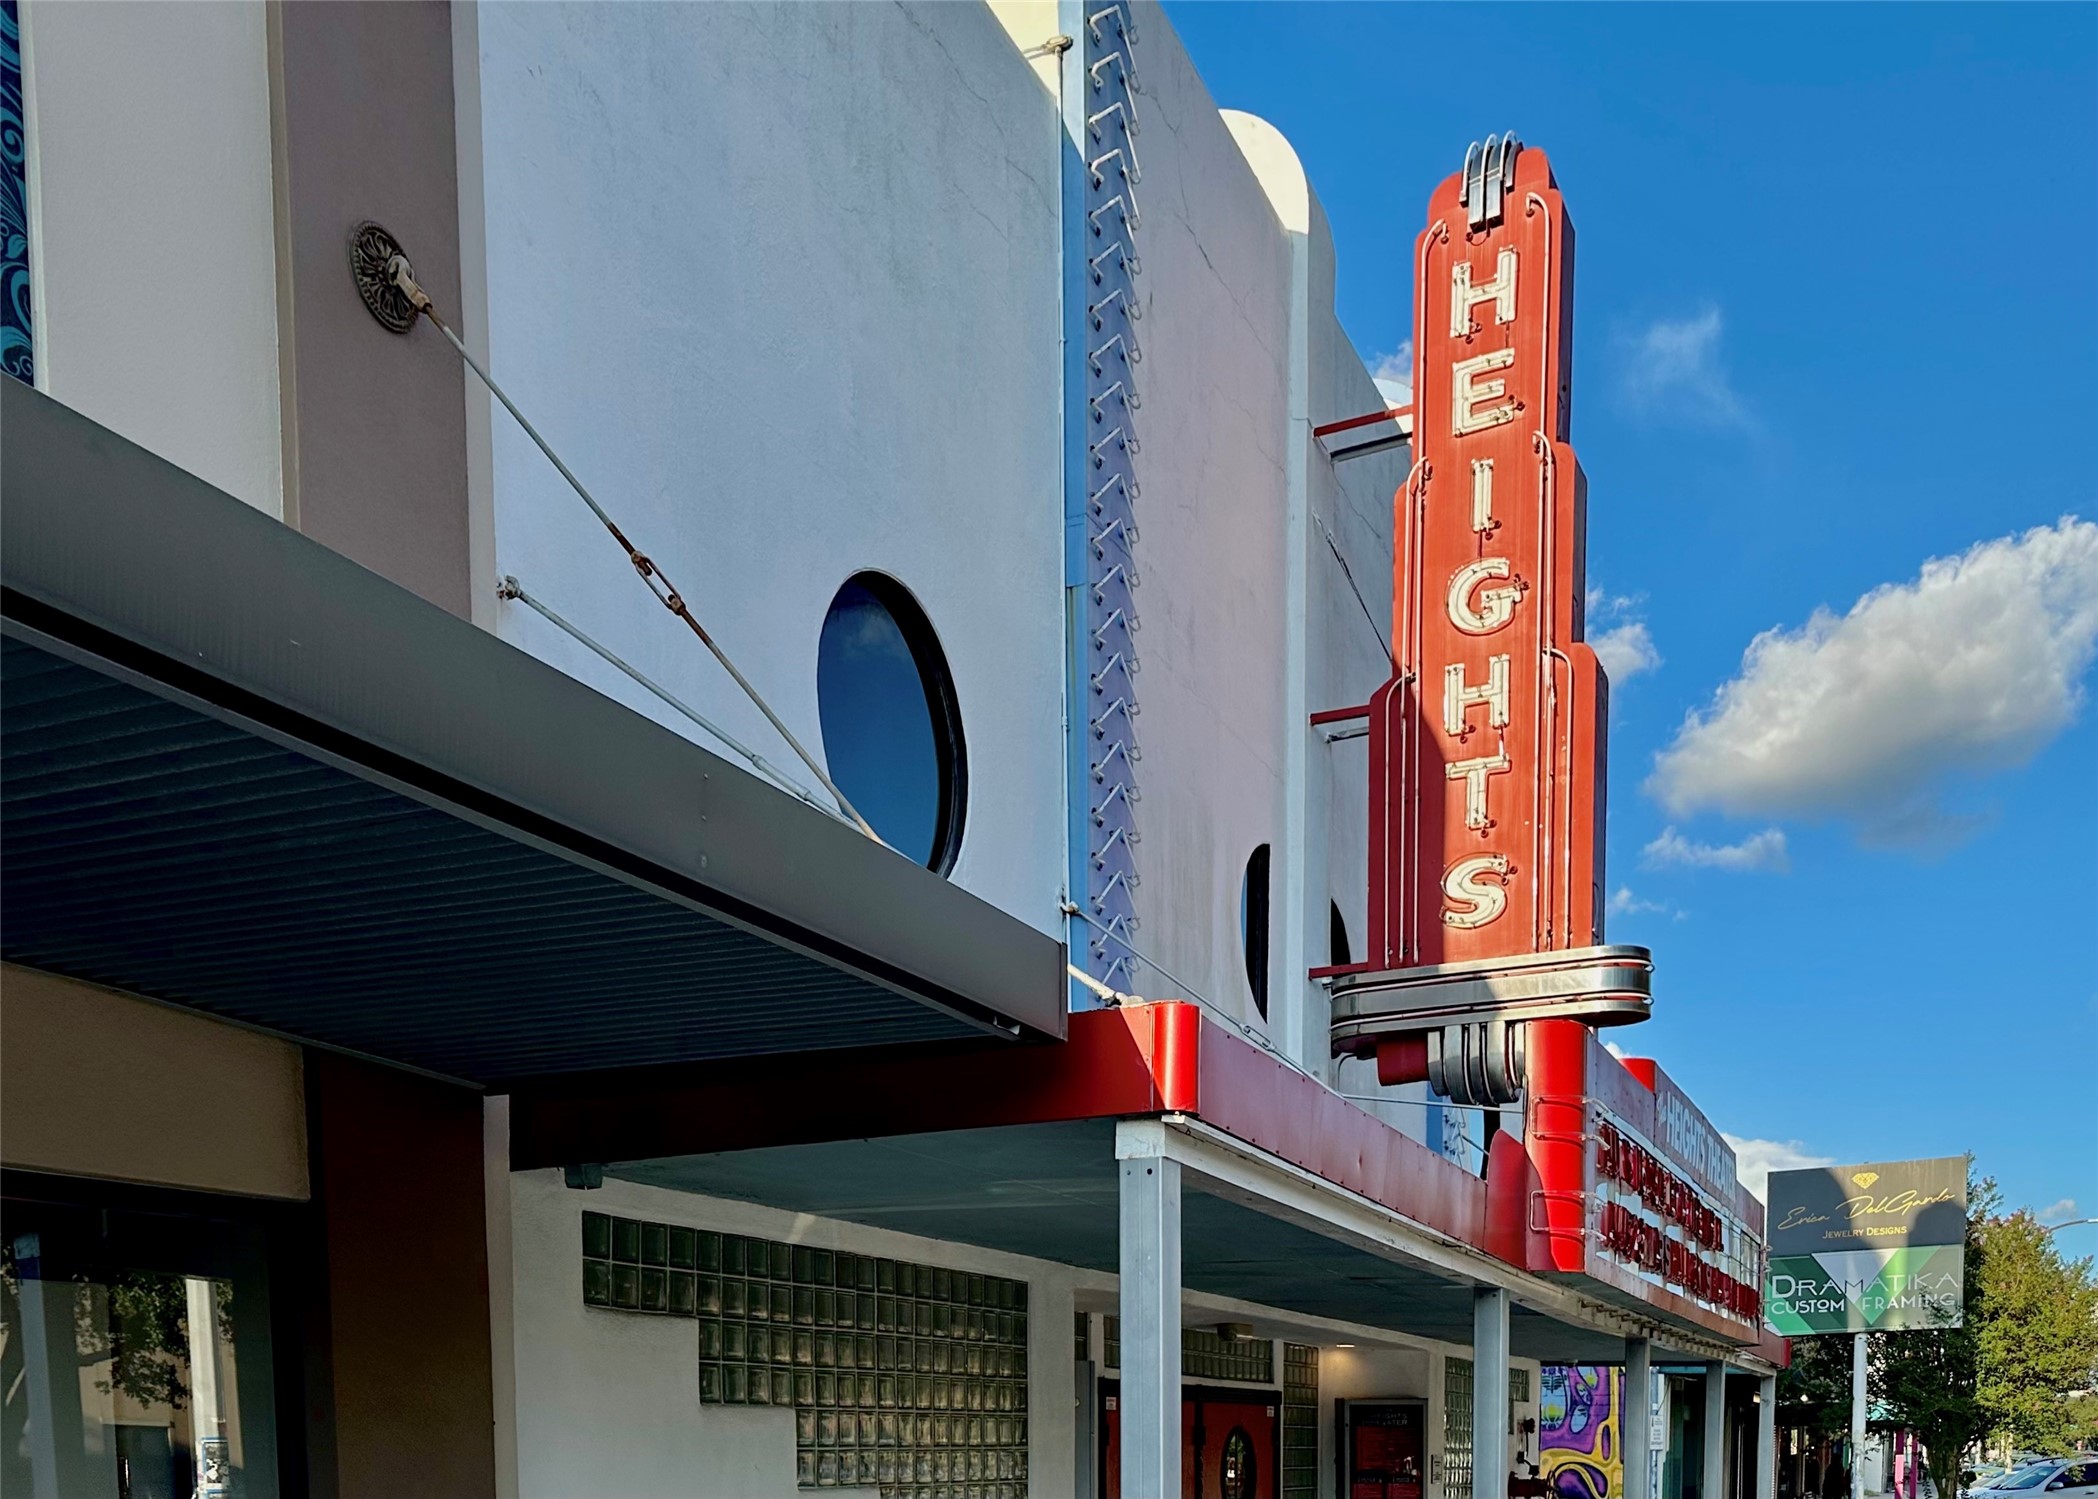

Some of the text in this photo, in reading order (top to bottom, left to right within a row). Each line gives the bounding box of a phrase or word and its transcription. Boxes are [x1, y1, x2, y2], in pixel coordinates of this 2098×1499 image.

[1440, 245, 1520, 929] HEIGHTS
[1667, 1091, 1706, 1174] HEIGHTS
[1777, 1206, 1831, 1230] Erica
[1822, 1225, 1907, 1239] JEWELRY DESIGNS
[1772, 1272, 1959, 1299] DRAMATIKA
[1771, 1299, 1845, 1315] CUSTOM
